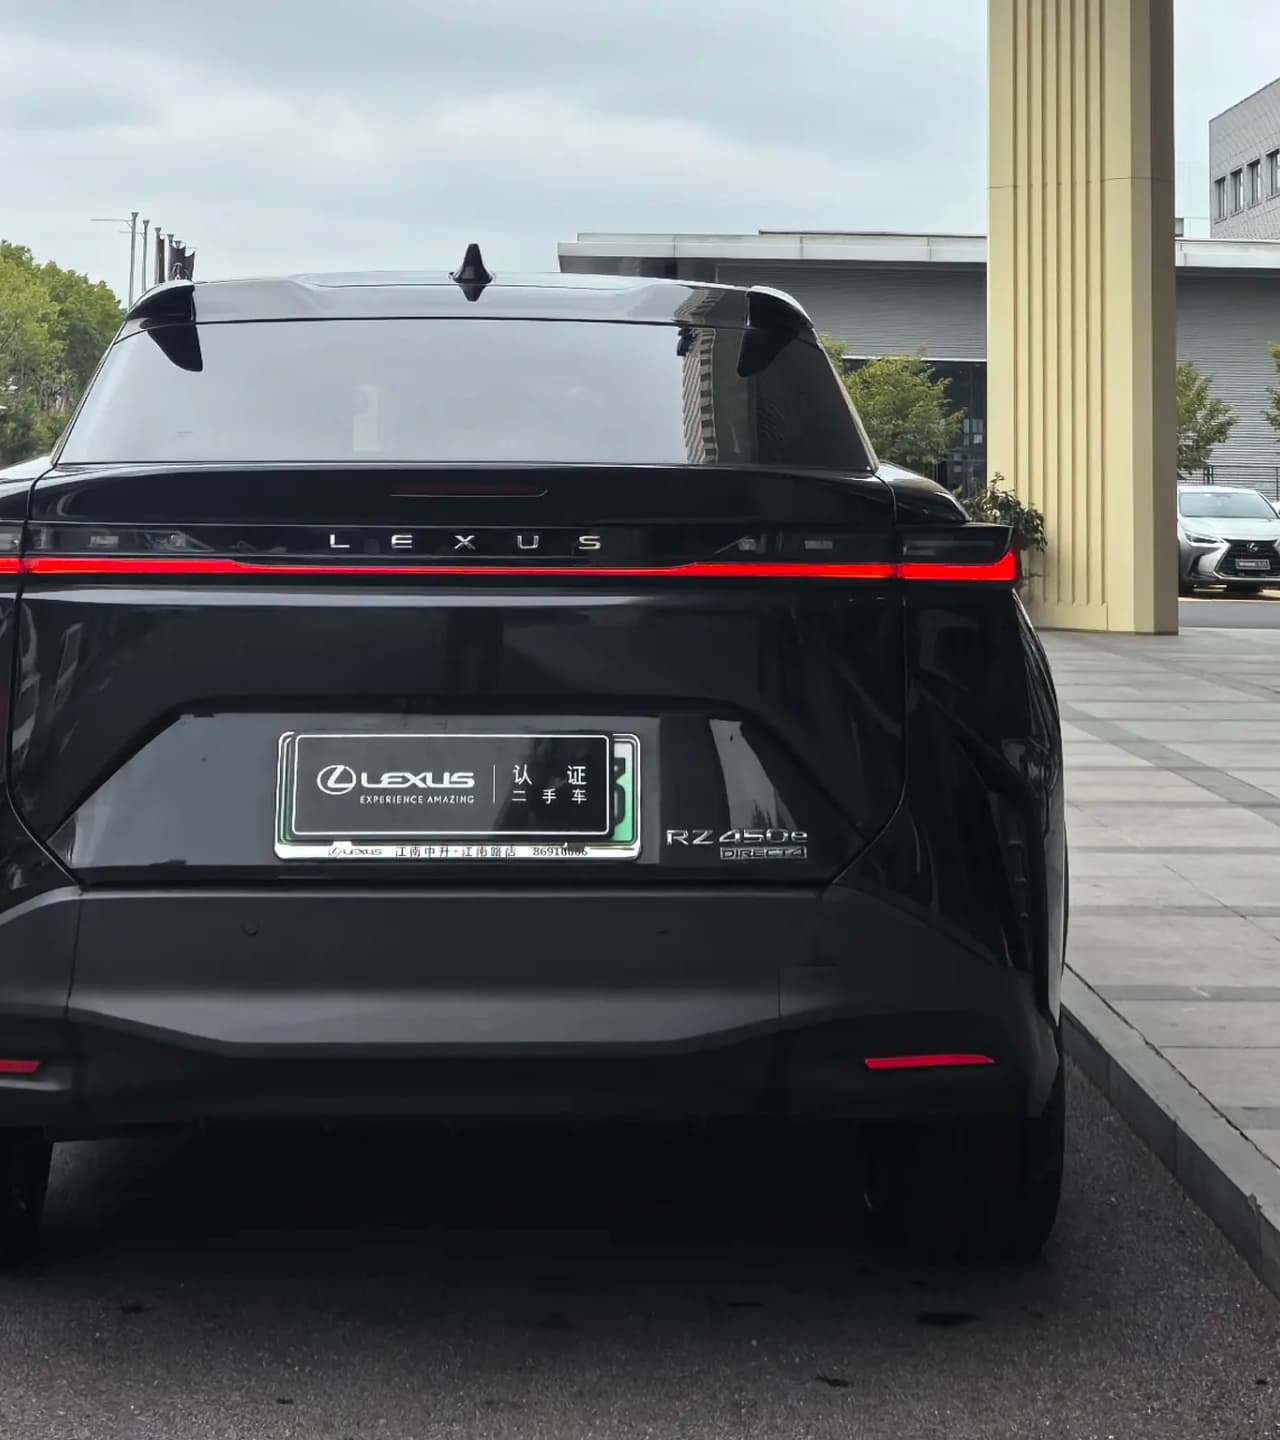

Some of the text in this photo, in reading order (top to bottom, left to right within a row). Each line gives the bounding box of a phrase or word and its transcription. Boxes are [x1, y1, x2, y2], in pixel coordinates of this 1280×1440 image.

[329, 533, 602, 550] LEXUS
[360, 771, 475, 789] LEXUS
[512, 763, 587, 786] 认证
[359, 795, 475, 805] EXPERIENCE AMAZING
[511, 788, 588, 805] 二手车
